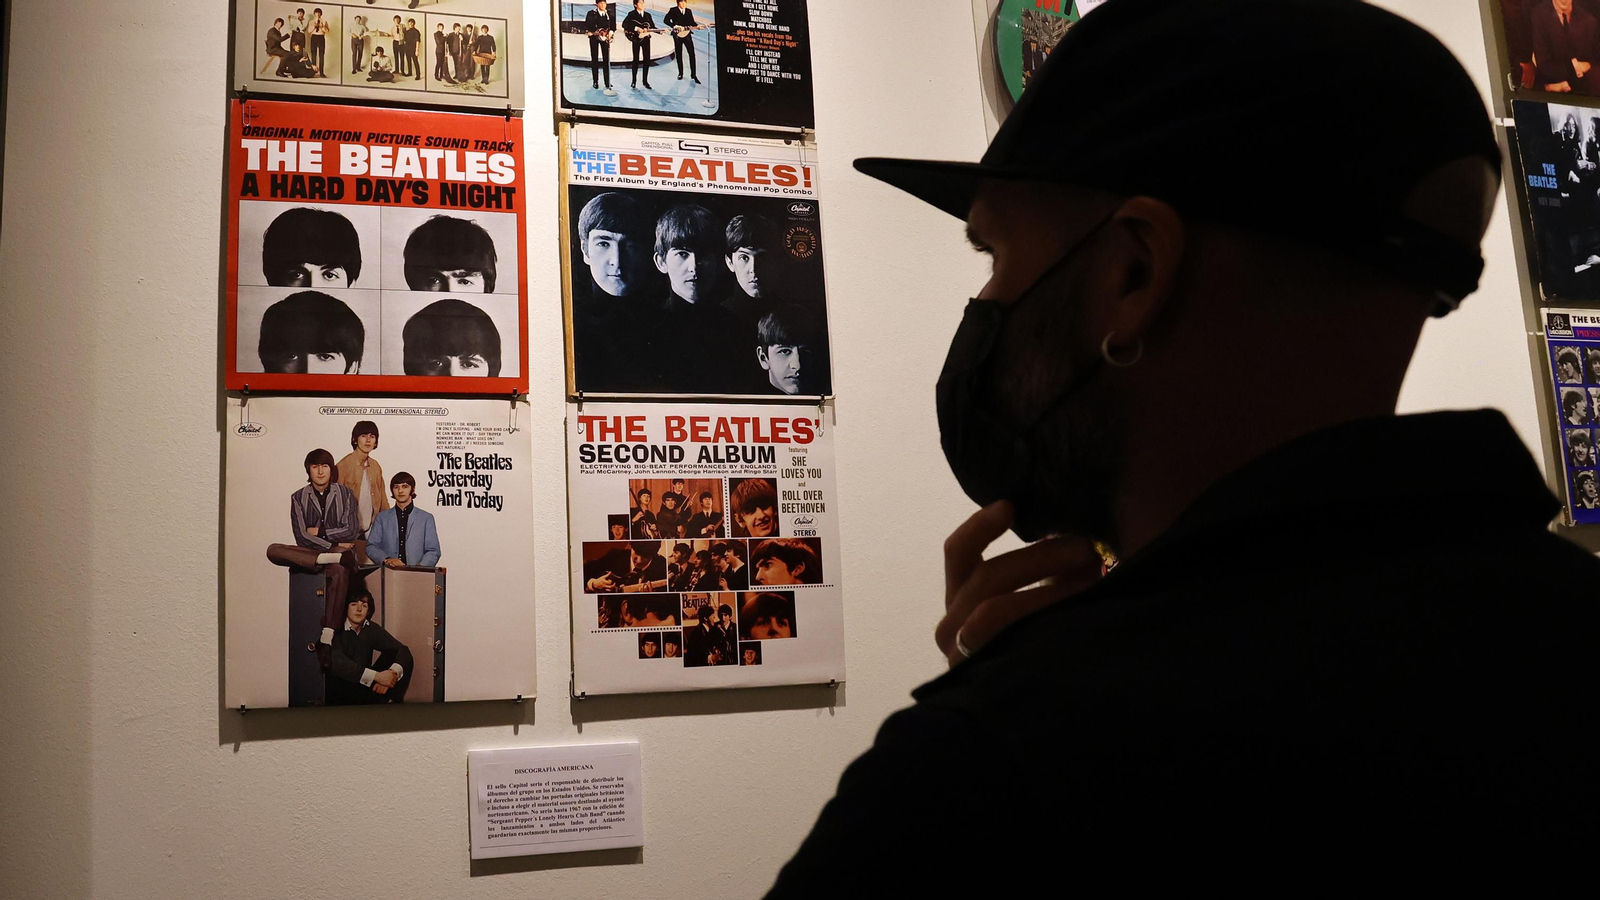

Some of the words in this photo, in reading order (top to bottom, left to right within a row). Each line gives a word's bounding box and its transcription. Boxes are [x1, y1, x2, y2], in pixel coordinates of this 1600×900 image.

[764, 50, 781, 58] INSTEAD
[242, 126, 304, 139] ORIGINAL
[309, 129, 361, 142] MOTION
[367, 132, 421, 146] PICTURE
[425, 136, 469, 149] SOUND
[474, 140, 515, 152] TRACK
[572, 151, 615, 161] MEET
[714, 147, 748, 155] STEREO
[241, 139, 322, 173] THE
[340, 144, 515, 185] BEATLES
[573, 162, 616, 175] THE
[619, 154, 811, 188] BEATLES!
[1542, 163, 1555, 175] THE
[707, 183, 760, 191] Phenomenal
[1528, 175, 1557, 189] BEATLES
[241, 173, 259, 197] A
[270, 174, 345, 200] HARD
[356, 178, 429, 205] DAY'S
[440, 182, 516, 210] NIGHT
[578, 416, 647, 442] THE
[665, 416, 820, 444] BEATLES'
[579, 444, 685, 463] SECOND
[697, 445, 776, 464] ALBUM
[437, 453, 462, 469] The
[465, 453, 512, 470] Beatles
[792, 456, 806, 466] SHE
[428, 470, 492, 490] Yesterday
[781, 469, 804, 478] LOVES
[807, 469, 821, 478] YOU
[437, 489, 462, 506] And
[465, 491, 503, 512] Today
[782, 491, 801, 500] ROLL
[803, 491, 822, 500] OVER
[782, 503, 825, 513] BEETHOVEN
[515, 766, 556, 774] DISCOGRAFÍA
